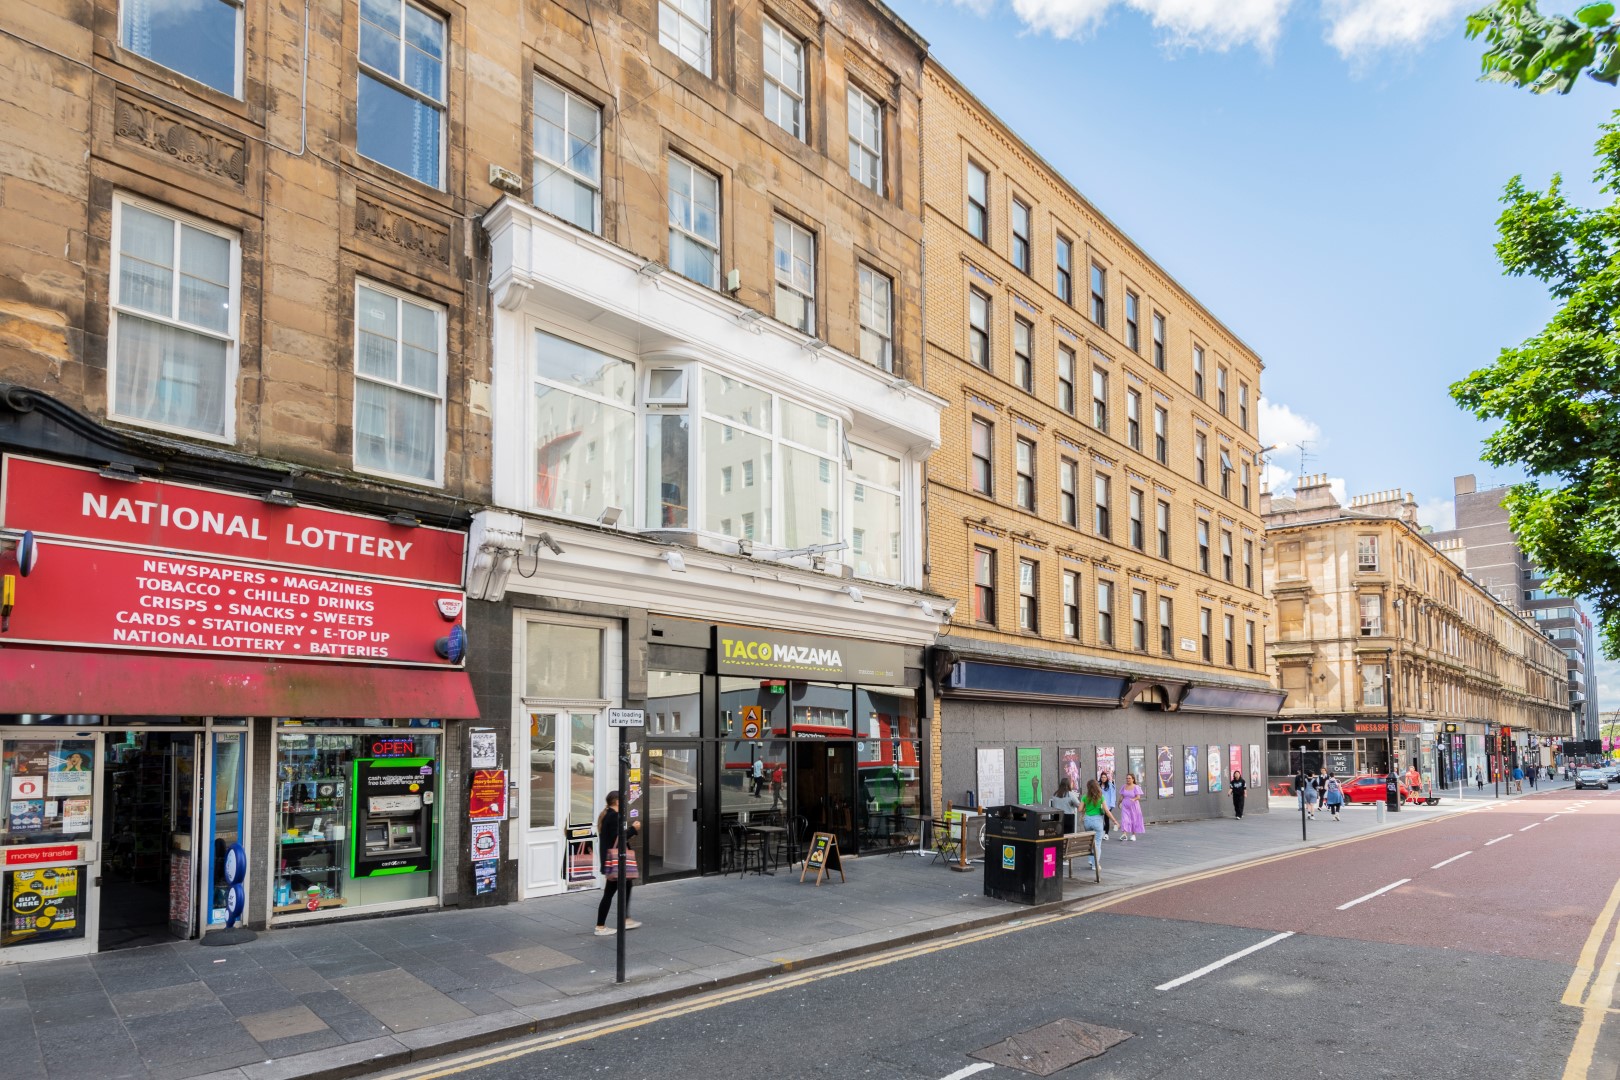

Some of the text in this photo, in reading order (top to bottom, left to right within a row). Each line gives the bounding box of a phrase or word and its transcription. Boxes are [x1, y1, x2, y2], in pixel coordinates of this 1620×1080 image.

[81, 491, 413, 561] NATIONAL LOTTERY
[143, 559, 373, 597] NEWSPAPERS MAGAZINES
[136, 576, 375, 612] TOBACCO CHILLED DRINKS
[139, 595, 374, 627] CRISPS SNACKS SWEETS
[116, 611, 390, 643] CARDS STATIONERY E-TOP UP
[113, 628, 389, 657] NATIONAL LOTTERY BATTERIES
[721, 638, 843, 667] TACO MAZAMA
[621, 711, 642, 719] loading
[1282, 723, 1323, 733] BAR
[372, 742, 413, 754] OPEN
[11, 849, 73, 860] money transfer
